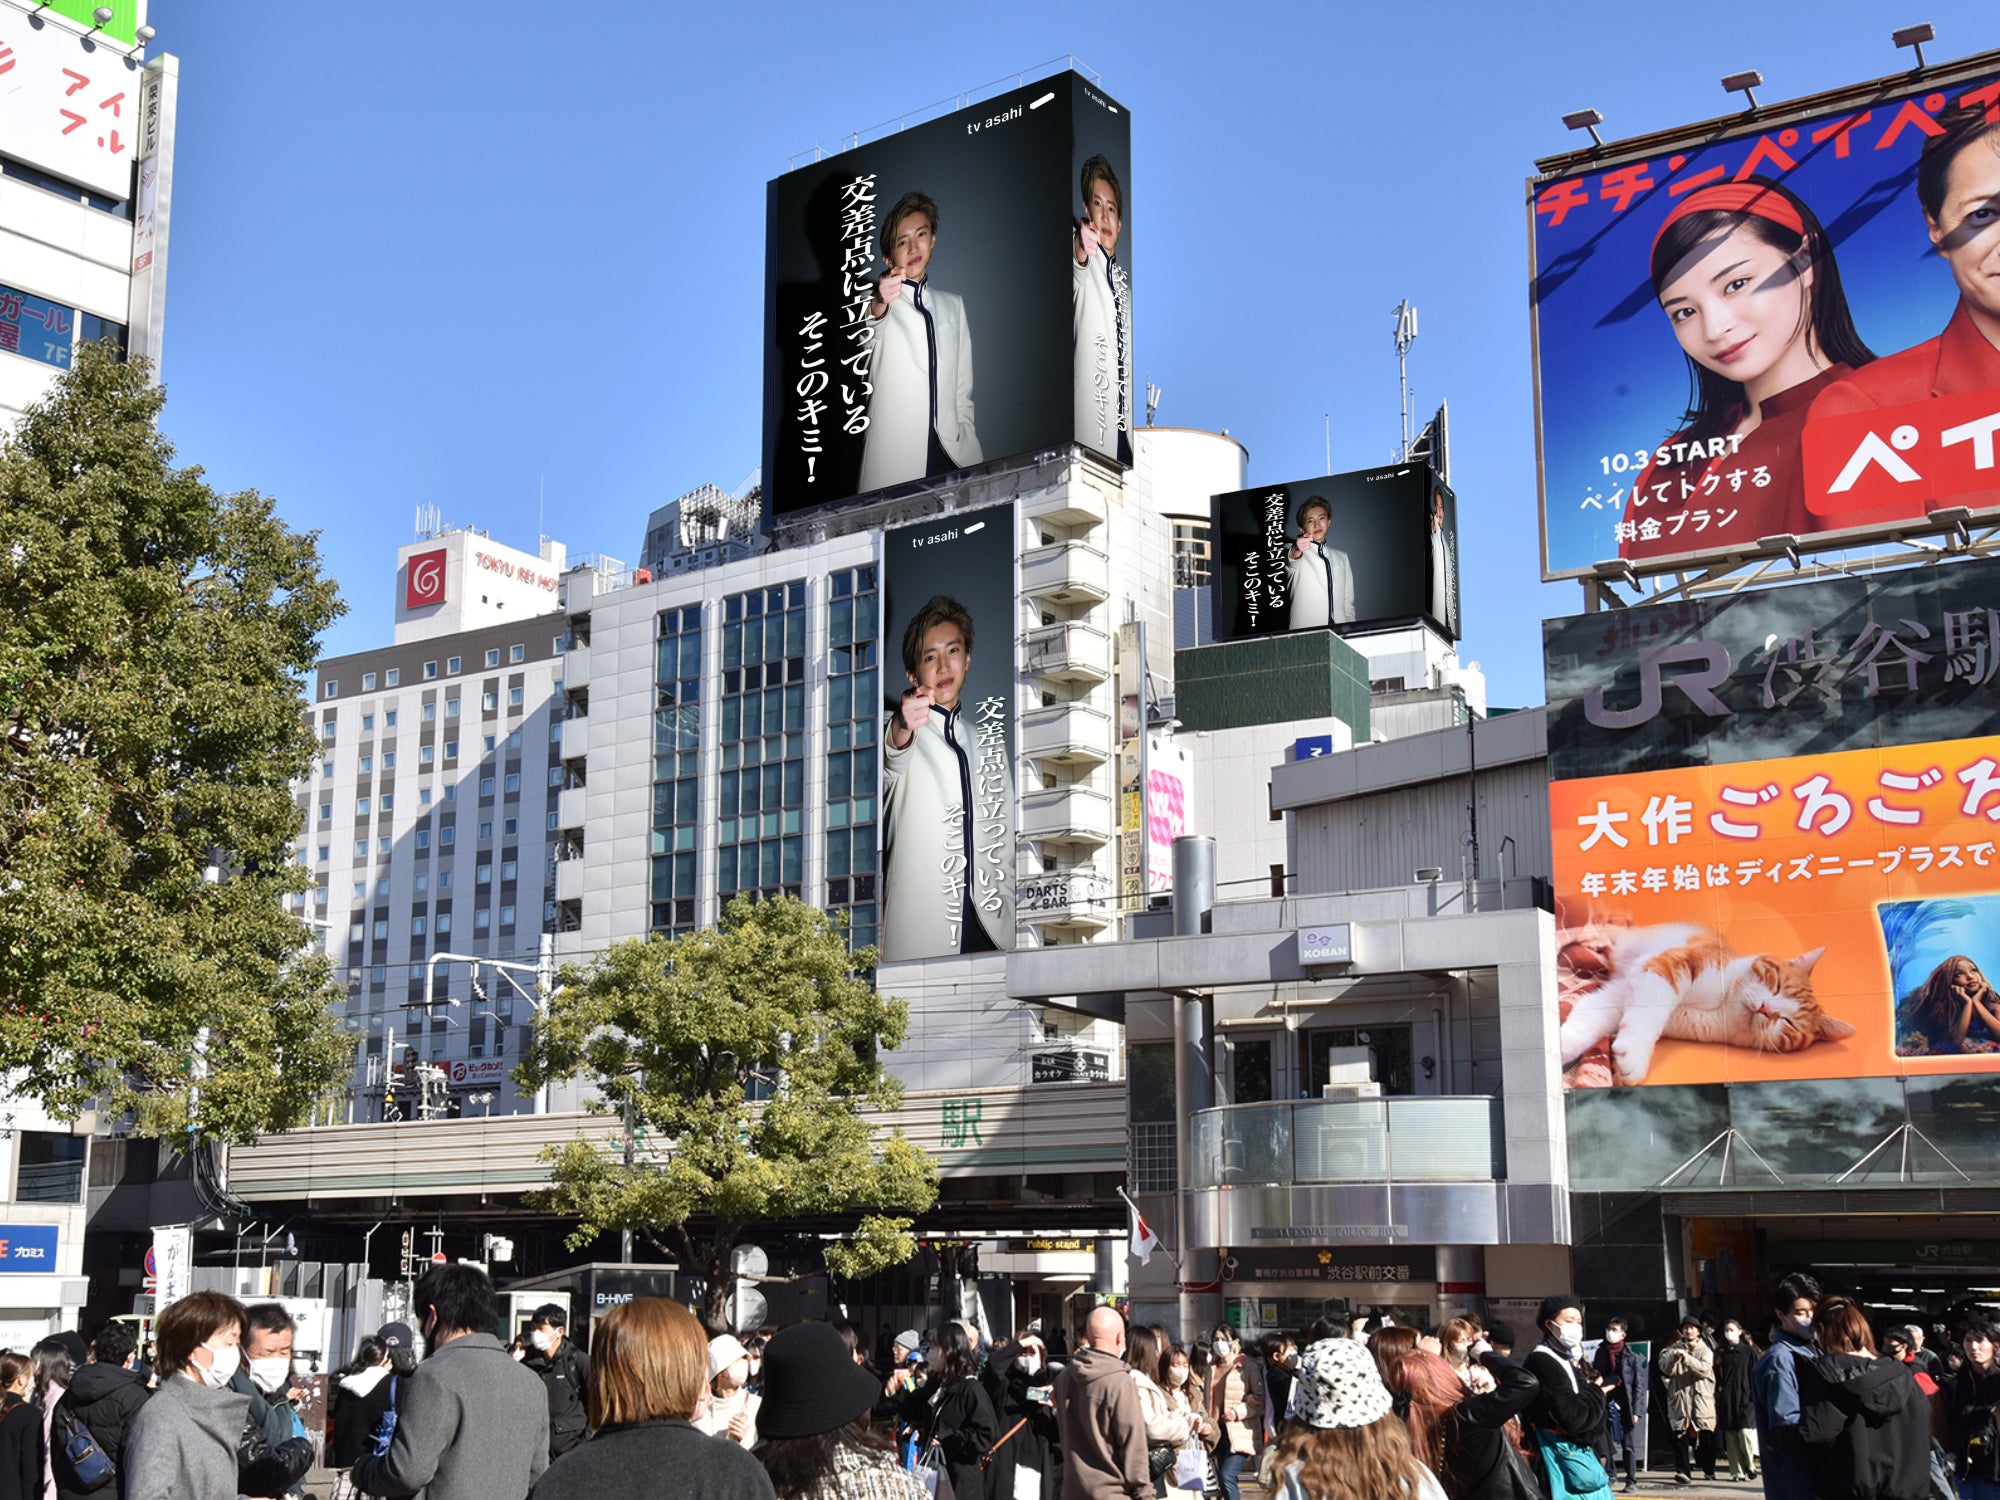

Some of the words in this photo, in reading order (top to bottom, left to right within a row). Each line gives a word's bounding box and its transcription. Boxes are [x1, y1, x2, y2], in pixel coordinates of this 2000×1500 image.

[1084, 87, 1091, 97] tv
[1092, 91, 1107, 109] asahi
[967, 121, 982, 135] tv
[985, 105, 1022, 130] asahi
[839, 174, 878, 435] 交差点に立っている
[43, 341, 68, 364] 7F
[797, 311, 829, 483] そこのキミ!
[1600, 450, 1650, 476] 10.3
[1655, 433, 1744, 468] START
[1367, 476, 1375, 484] tv
[1375, 471, 1395, 482] asahi
[1580, 465, 1773, 512] ペイしてトクする
[1614, 505, 1739, 544] 料金プラン
[912, 535, 925, 548] tv
[927, 529, 958, 546] asahi
[1264, 493, 1286, 609] 交差点に立っている
[476, 551, 515, 578] TOKYU
[517, 567, 536, 585] REI
[1244, 551, 1262, 627] そこのキミ!
[1584, 638, 1735, 729] JR
[975, 696, 1006, 913] 交差点に立っている
[940, 804, 969, 946] そこのキミ!
[1581, 840, 1997, 899] 年末年始はディズニープラスで
[1026, 883, 1067, 899] DARTS
[1042, 896, 1067, 910] BAR
[1304, 947, 1347, 958] KOBAN
[1034, 1070, 1062, 1079] カラオケ
[1336, 1225, 1372, 1237] POLICE
[1379, 1225, 1400, 1237] BOX
[14, 1247, 45, 1258] プロミス
[1027, 1240, 1053, 1249] Public
[1055, 1240, 1080, 1249] stand
[1916, 1245, 1939, 1257] JR
[1327, 1265, 1410, 1280] 渋谷駅前交番
